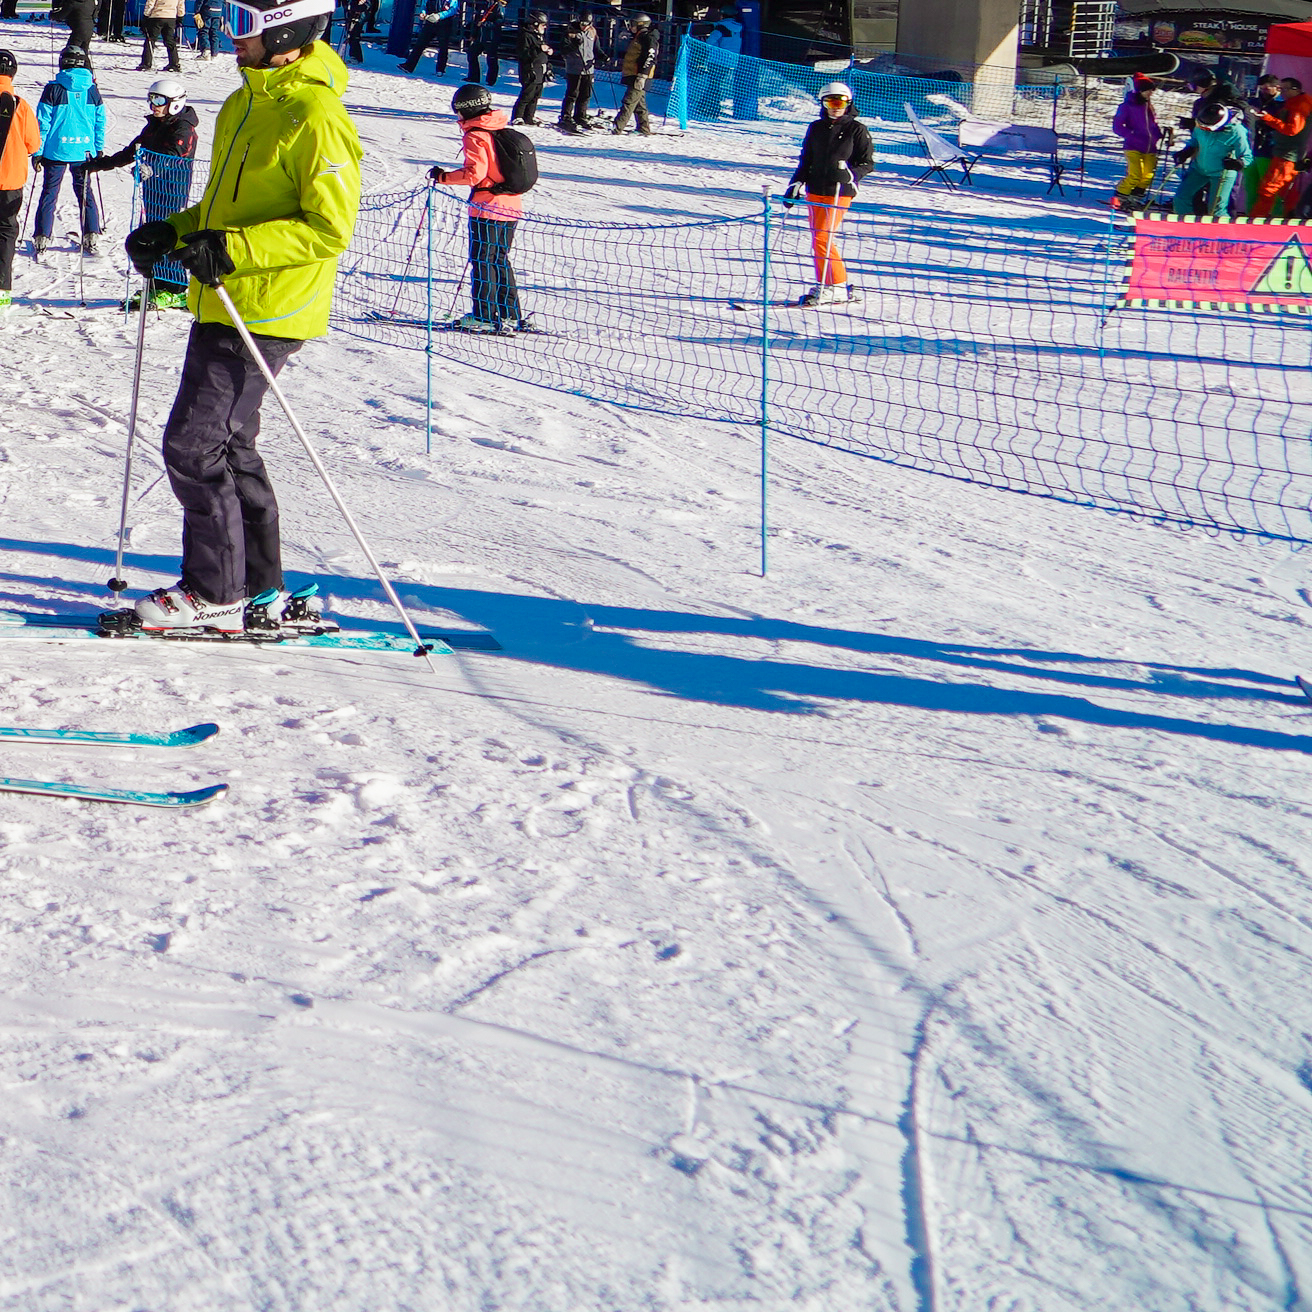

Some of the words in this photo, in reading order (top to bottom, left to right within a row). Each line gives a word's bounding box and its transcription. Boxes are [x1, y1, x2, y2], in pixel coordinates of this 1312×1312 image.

[1193, 22, 1220, 30] STEAK
[1230, 22, 1258, 32] HOUSE
[193, 606, 242, 623] NORDICA
